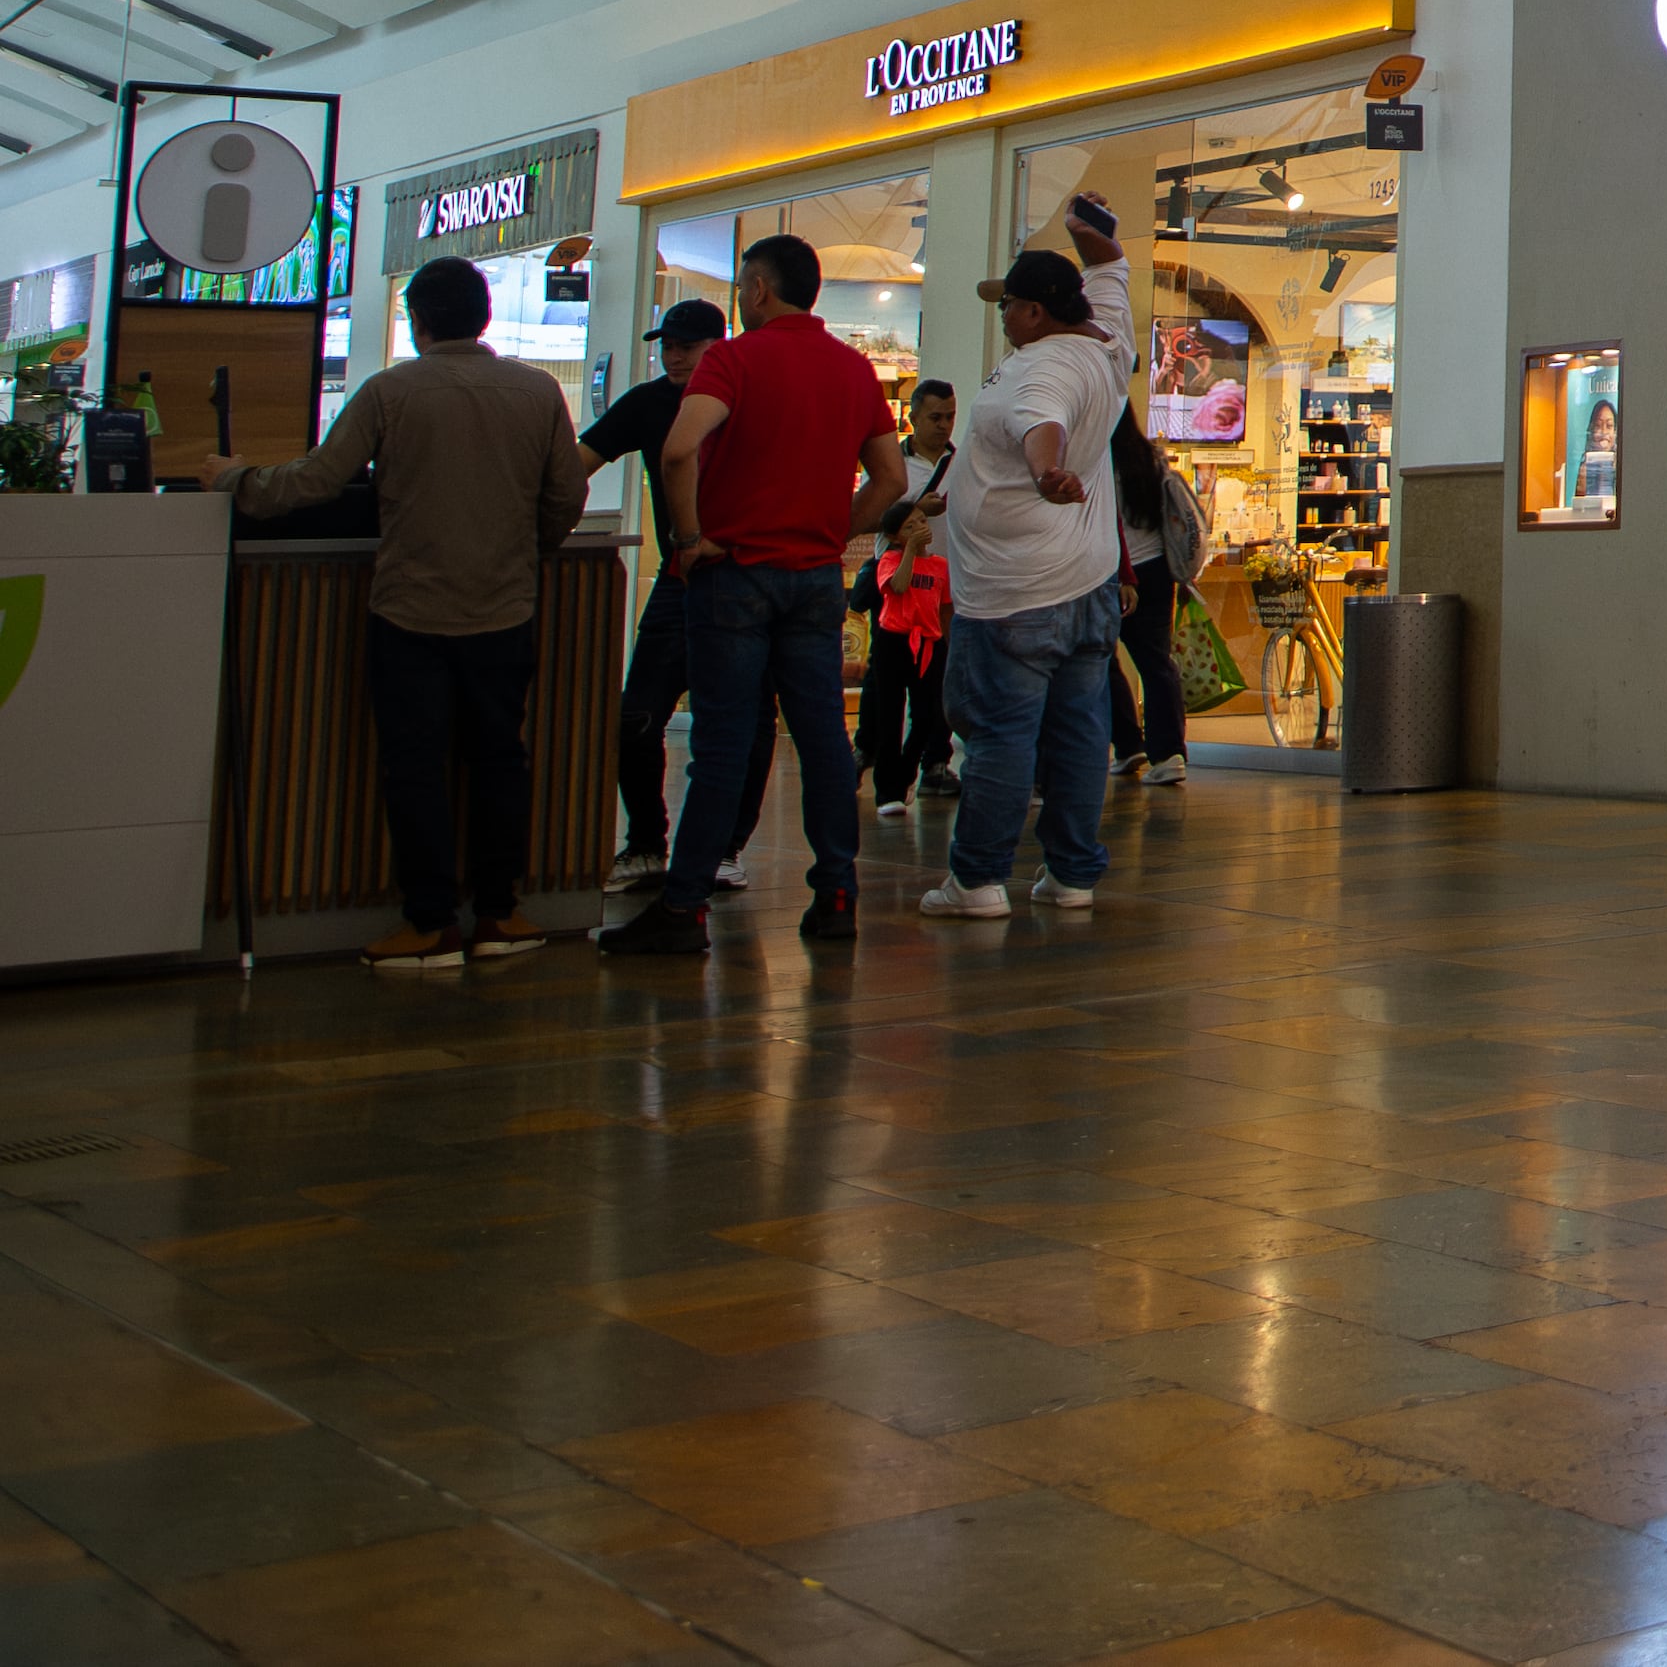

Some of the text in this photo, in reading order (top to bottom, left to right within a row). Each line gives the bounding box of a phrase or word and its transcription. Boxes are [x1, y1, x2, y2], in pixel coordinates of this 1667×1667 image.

[889, 73, 986, 117] EN PROVENCE
[1381, 71, 1407, 87] VIP
[438, 173, 528, 235] SWAROVSKI
[1369, 178, 1396, 199] 1243
[1555, 462, 1566, 509] 1
